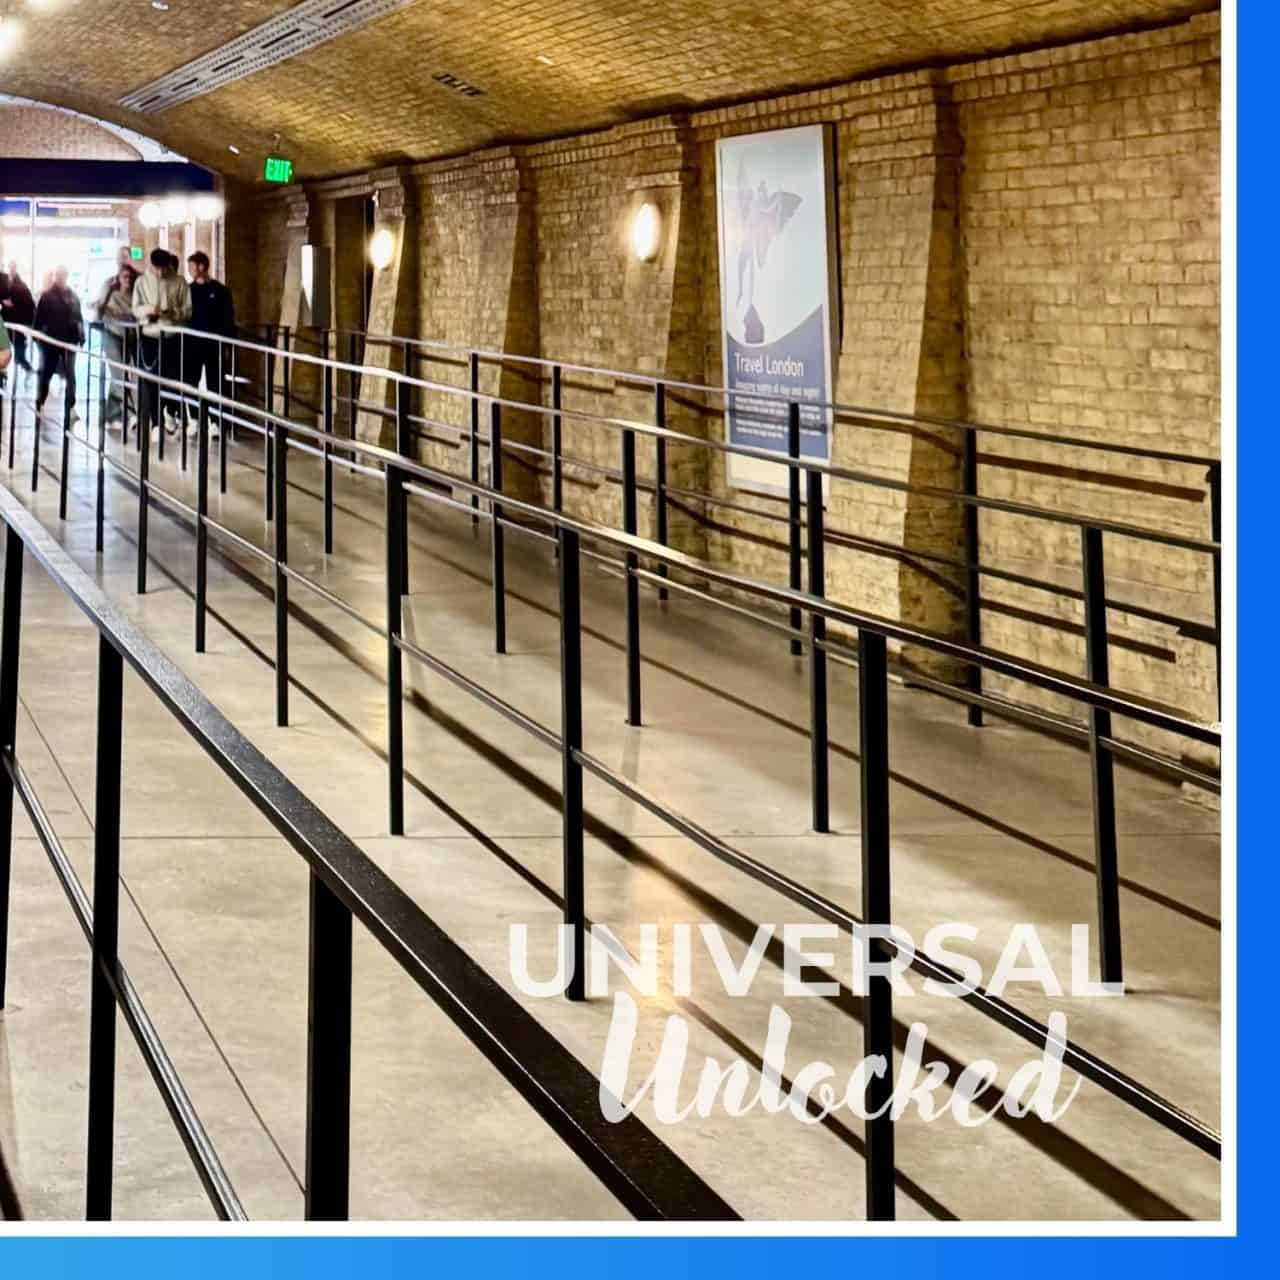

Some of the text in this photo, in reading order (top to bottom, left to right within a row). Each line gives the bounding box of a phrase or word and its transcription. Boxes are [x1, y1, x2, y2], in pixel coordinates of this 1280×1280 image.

[266, 158, 291, 183] EXIT
[734, 352, 804, 376] Travel London
